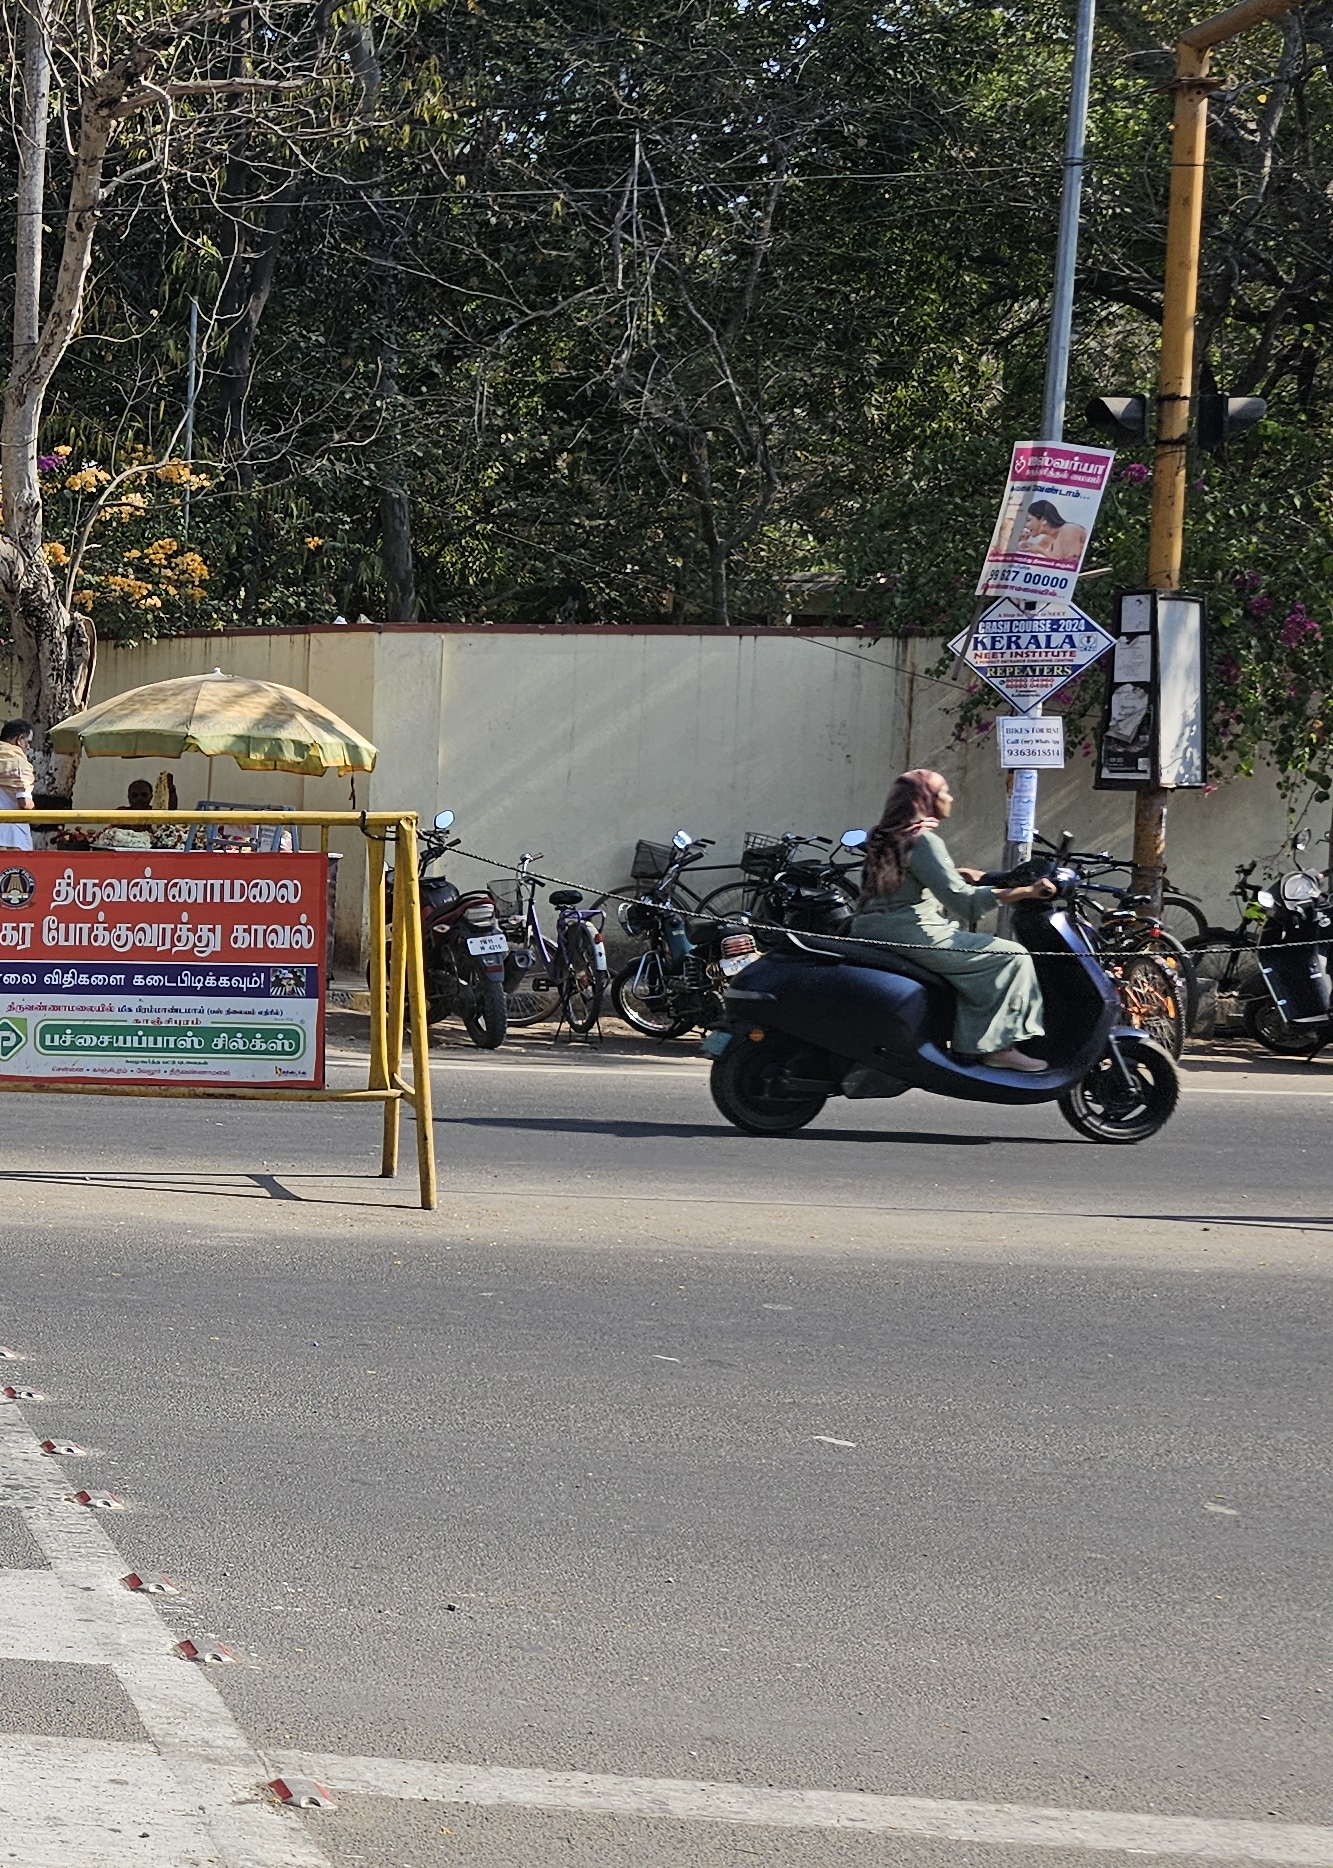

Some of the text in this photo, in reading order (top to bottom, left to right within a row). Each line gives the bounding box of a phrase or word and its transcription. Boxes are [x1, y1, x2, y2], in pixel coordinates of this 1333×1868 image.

[1023, 572, 1069, 589] 00000
[978, 620, 1011, 634] CRASH
[1012, 620, 1051, 633] COURSE
[1058, 619, 1086, 631] 2024
[973, 634, 1077, 650] KERALA
[973, 650, 1077, 660] NEET INSTITUTE
[986, 665, 1073, 677] REPEATERS
[1032, 726, 1044, 734] FOR
[50, 867, 302, 909] திருவண்ணாமலை
[41, 912, 222, 957] போக்குவரத்து
[230, 914, 316, 949] காவல்
[43, 969, 126, 988] விதிகளை
[132, 969, 265, 992] கடைபிடிக்கவும்!
[6, 1001, 115, 1013] திருவண்ணாமலையில்
[117, 1004, 133, 1013] மிக
[135, 1005, 205, 1015] பிரம்மாண்டமாய்
[44, 1028, 296, 1052] பச்சையப்பாஸ் சில்க்ஸ்
